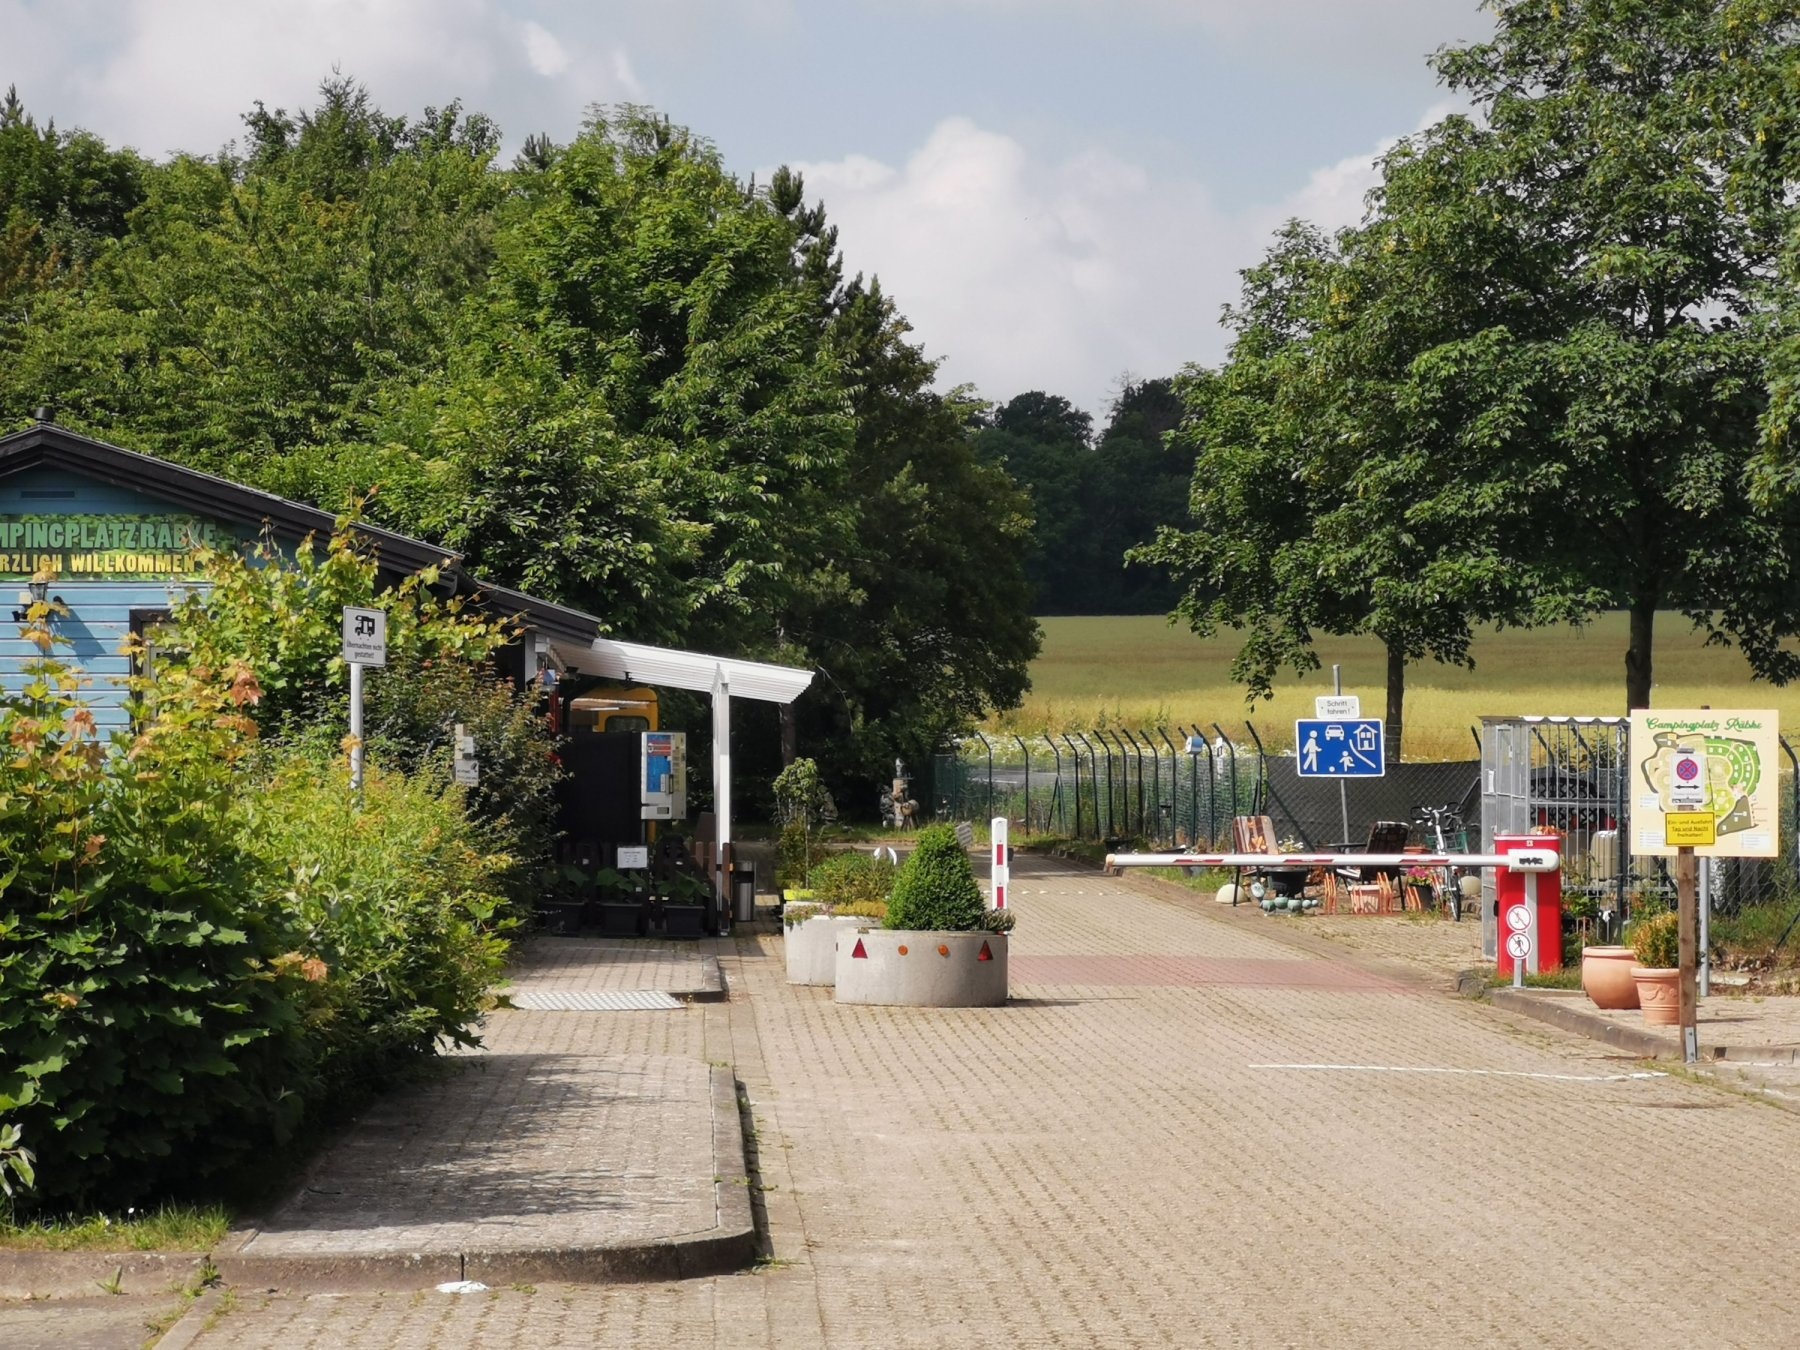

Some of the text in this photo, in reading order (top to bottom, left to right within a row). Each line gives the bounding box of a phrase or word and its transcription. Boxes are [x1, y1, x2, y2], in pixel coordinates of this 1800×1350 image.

[70, 553, 195, 573] WILLKOMMEN
[1646, 717, 1762, 733] Campingplatz Räbke
